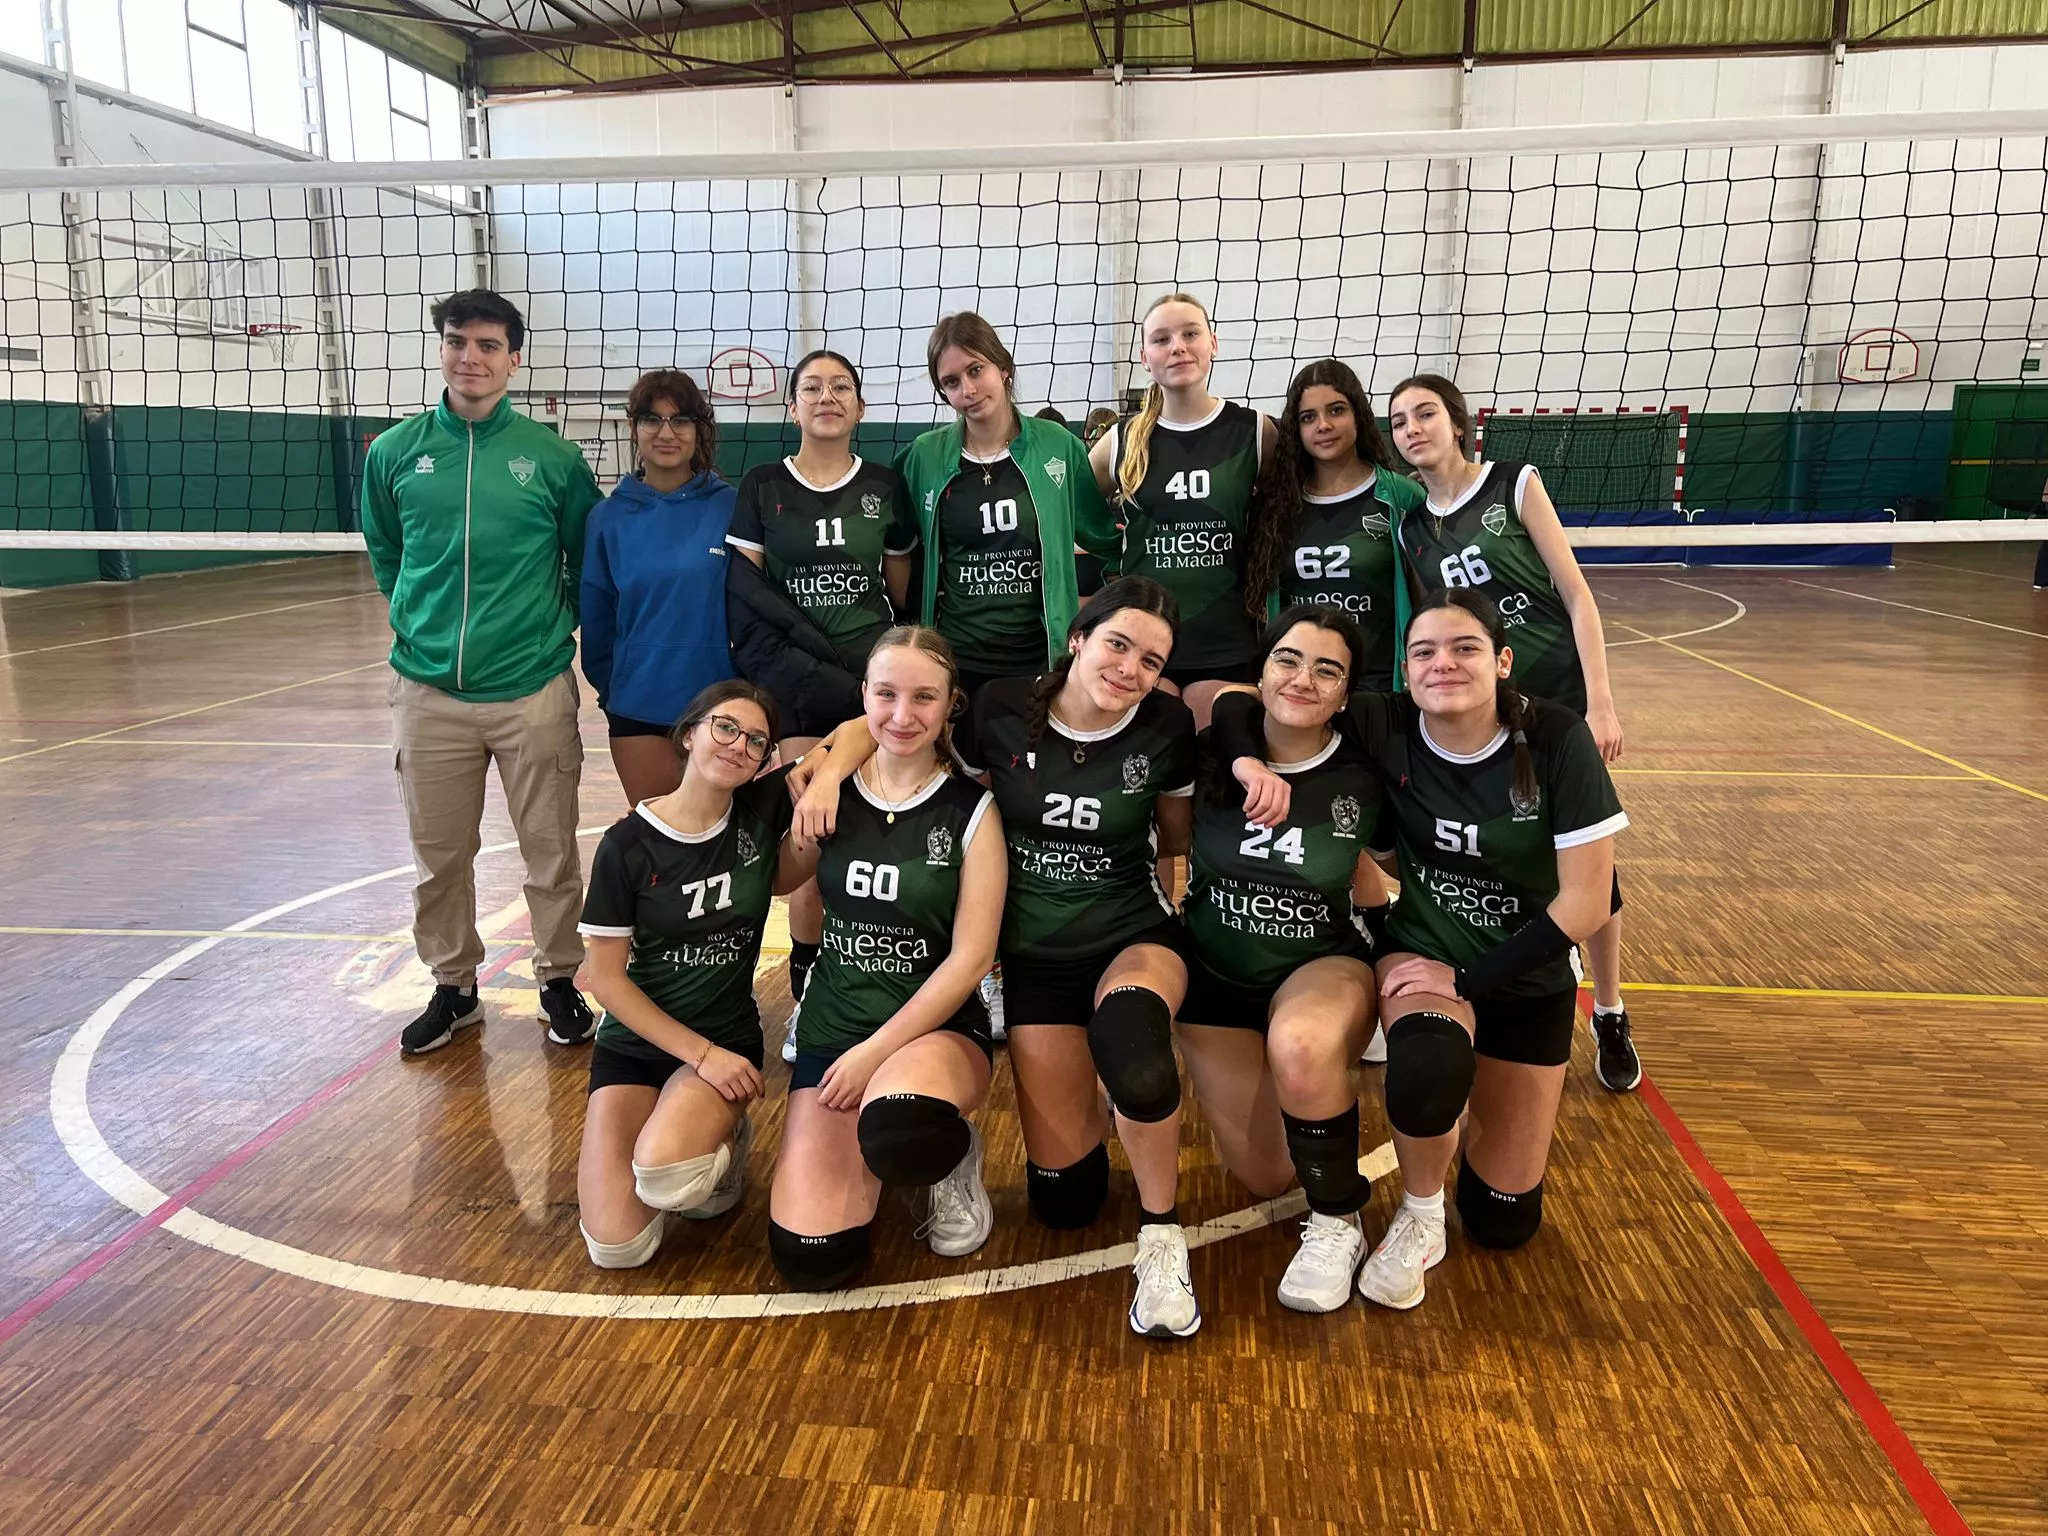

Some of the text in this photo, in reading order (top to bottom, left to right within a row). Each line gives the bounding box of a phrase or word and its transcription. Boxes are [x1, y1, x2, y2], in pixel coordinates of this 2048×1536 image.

[1165, 469, 1210, 500] 40
[815, 517, 846, 547] 11
[979, 498, 1018, 534] 10
[1145, 532, 1233, 554] Huesca
[1295, 545, 1350, 580] 62
[1439, 544, 1492, 588] 66
[786, 573, 869, 594] Huesca
[1042, 792, 1102, 831] 26
[1239, 821, 1305, 865] 24
[1434, 817, 1482, 857] 51
[681, 871, 732, 919] 77
[846, 860, 900, 901] 60
[1208, 886, 1330, 923] Huesca
[823, 930, 929, 959] Huesca
[1490, 1190, 1516, 1202] KIPSTA
